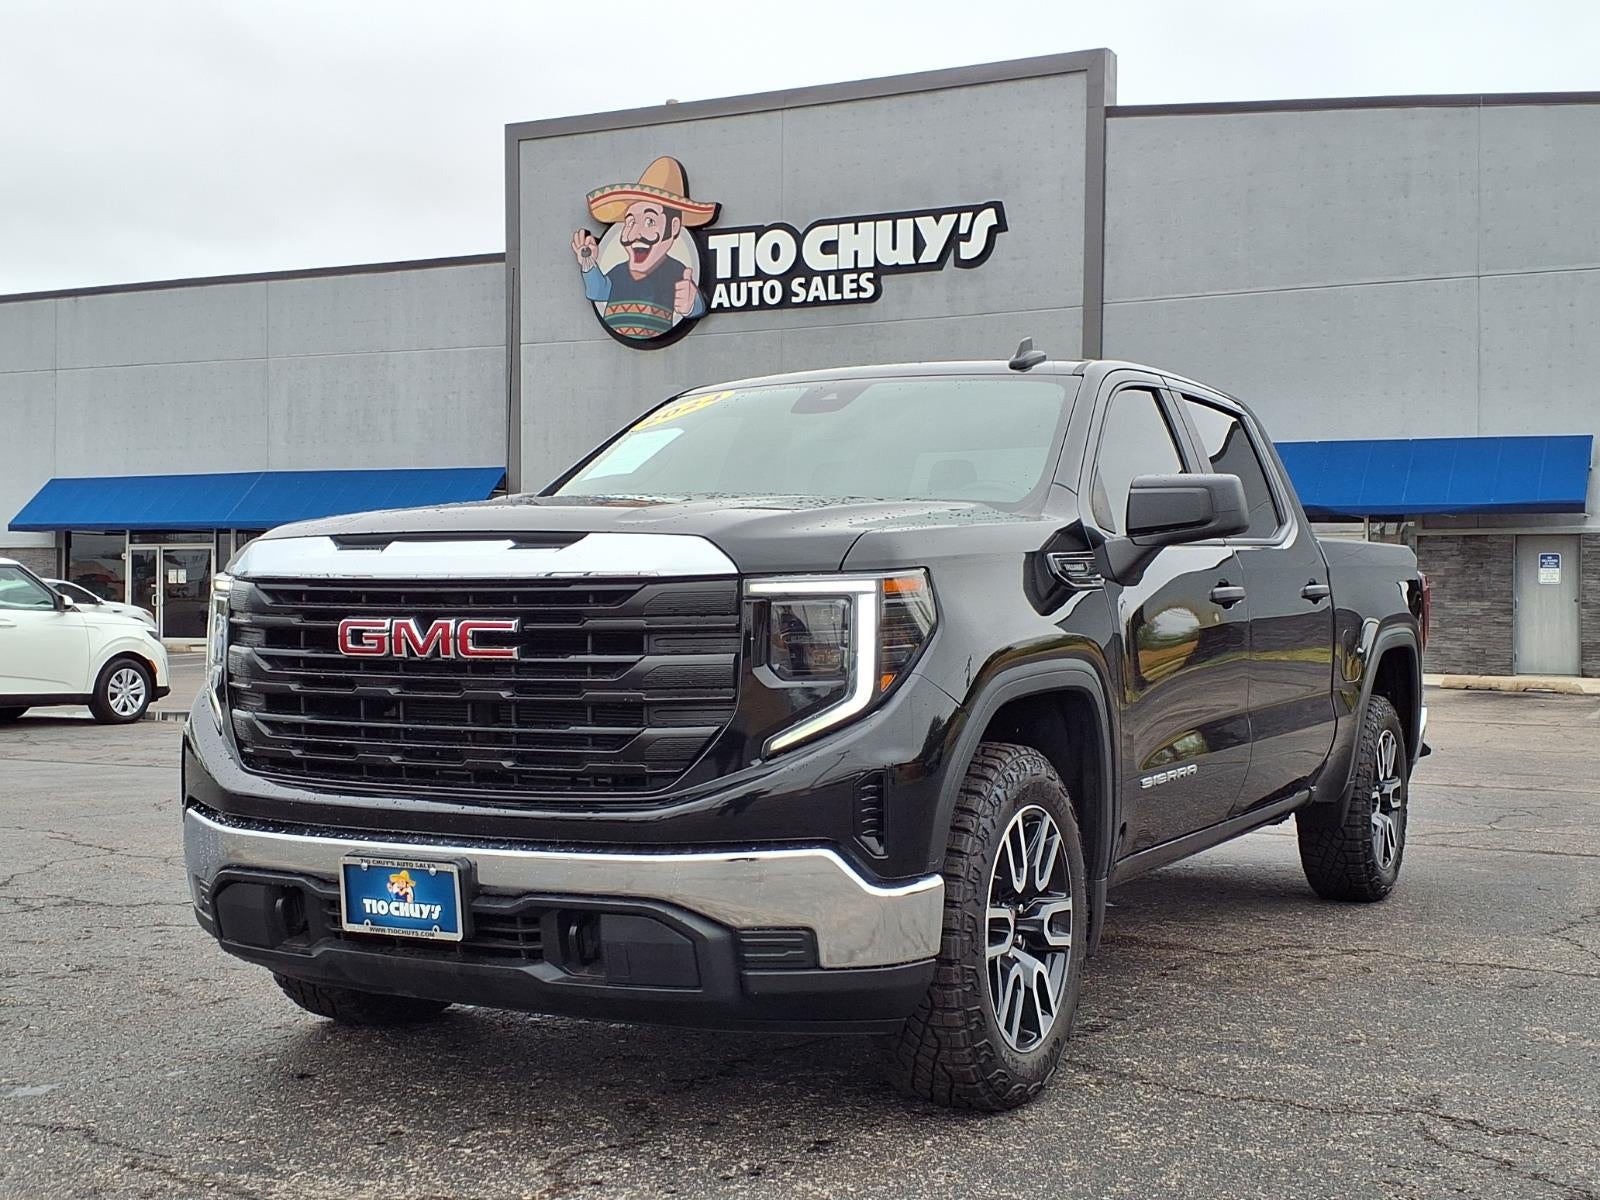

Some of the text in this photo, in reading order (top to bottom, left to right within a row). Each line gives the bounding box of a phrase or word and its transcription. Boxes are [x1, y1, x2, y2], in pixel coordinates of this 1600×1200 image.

[708, 207, 998, 279] TIO CHUY'S
[710, 272, 875, 309] AUTO SALES
[337, 617, 520, 660] GMC
[1139, 764, 1198, 789] SIERRA
